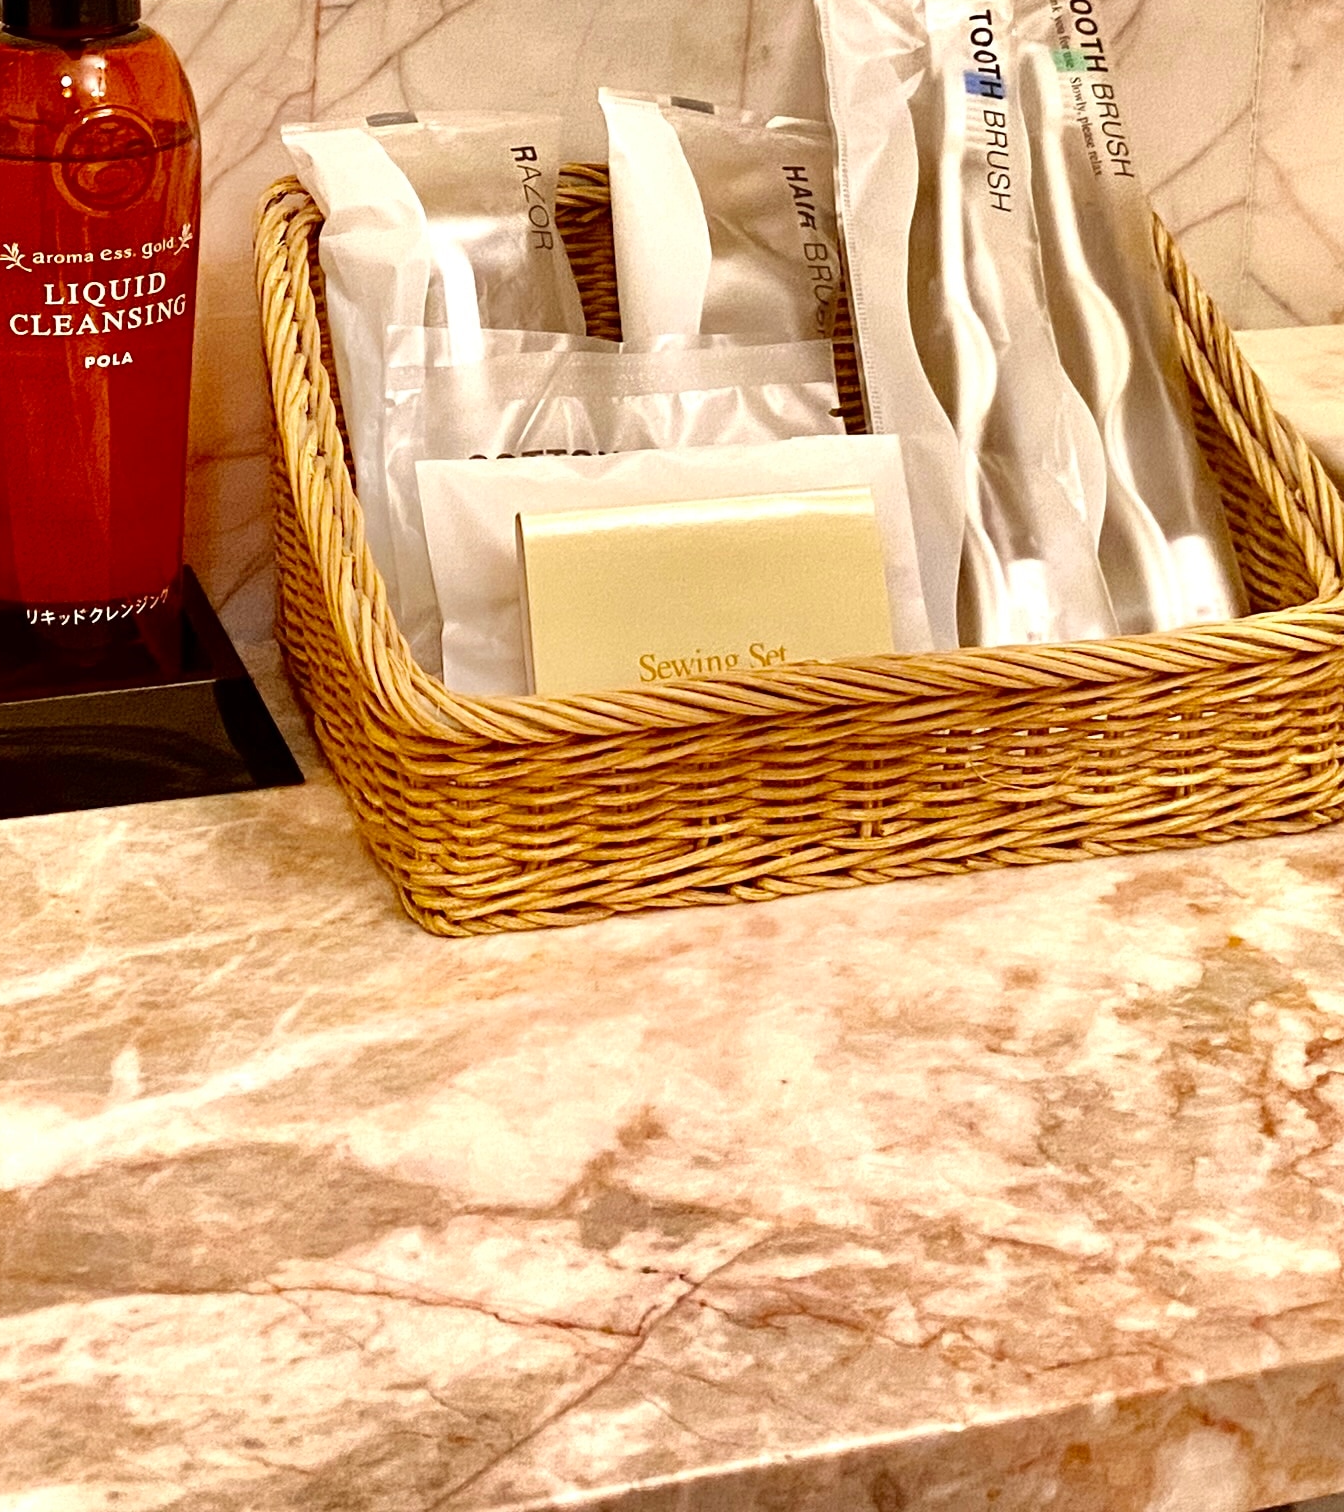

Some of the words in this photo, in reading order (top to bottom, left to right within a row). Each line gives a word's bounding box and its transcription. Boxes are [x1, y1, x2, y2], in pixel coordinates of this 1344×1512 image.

[969, 9, 1004, 100] TOOTH
[1091, 83, 1135, 178] BRUSH
[982, 109, 1012, 213] BRUSH
[31, 247, 95, 266] aroma
[98, 246, 137, 264] ess.
[141, 236, 175, 262] gold
[44, 271, 167, 307] LIQUID
[9, 294, 187, 337] CLEANSING
[84, 351, 134, 369] POLA
[26, 585, 170, 626] リキッドクレンジング
